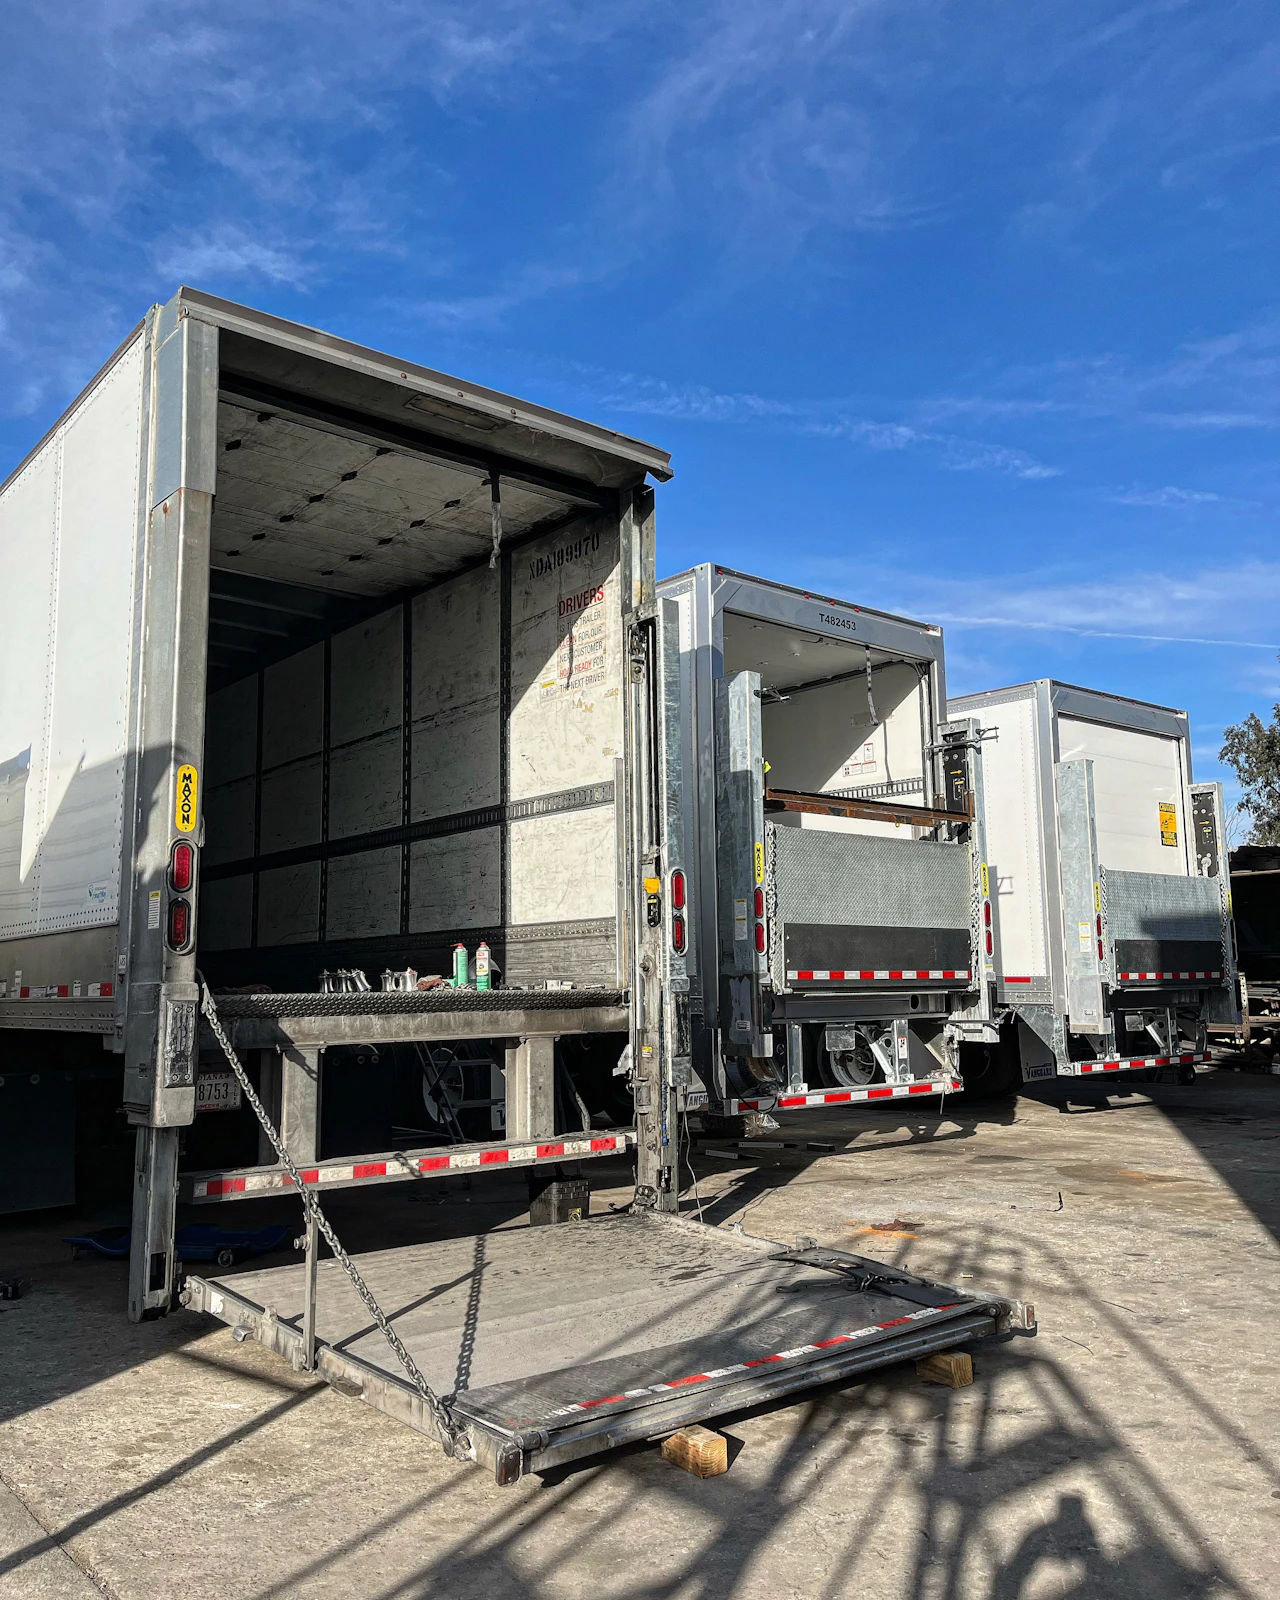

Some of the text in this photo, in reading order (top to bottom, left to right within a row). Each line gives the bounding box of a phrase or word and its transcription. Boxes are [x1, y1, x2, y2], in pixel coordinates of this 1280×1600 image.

[558, 584, 605, 617] DRIVERS
[579, 610, 601, 627] TRAILER
[819, 612, 857, 631] T482453
[578, 630, 590, 642] FOR
[590, 625, 603, 638] OUR
[574, 640, 603, 658] CUSTOMER
[574, 659, 592, 674] READY
[592, 655, 604, 667] FOR
[570, 678, 584, 690] NEXT
[182, 773, 192, 824] MAXON
[198, 1083, 229, 1101] 8753
